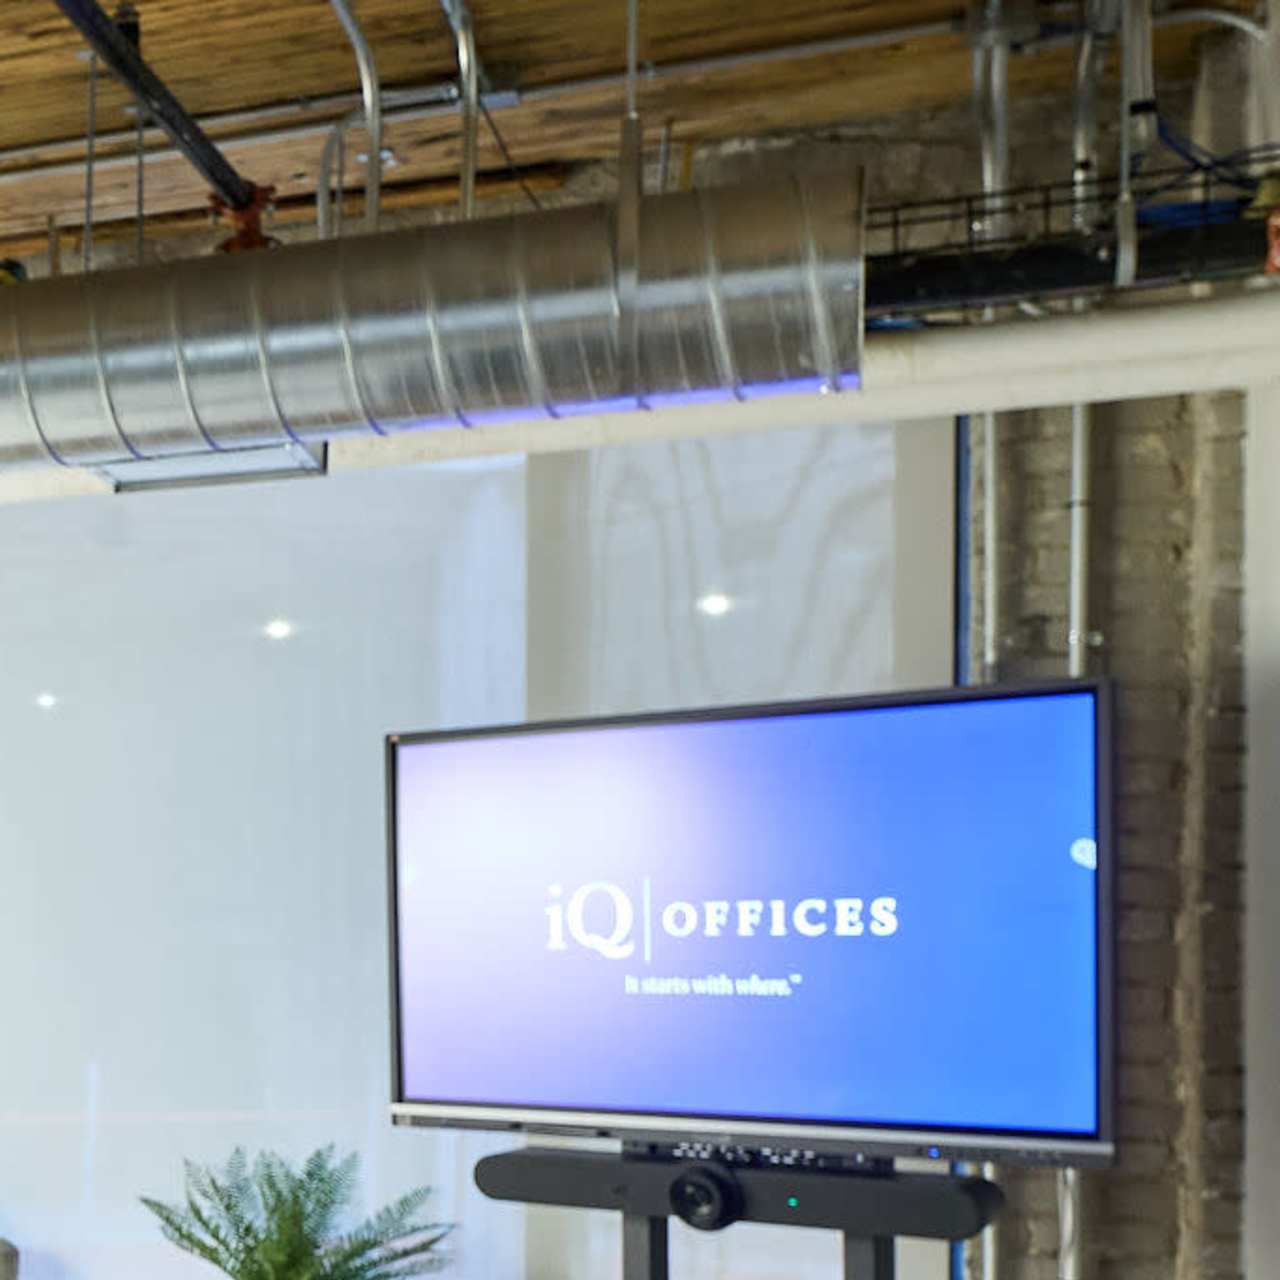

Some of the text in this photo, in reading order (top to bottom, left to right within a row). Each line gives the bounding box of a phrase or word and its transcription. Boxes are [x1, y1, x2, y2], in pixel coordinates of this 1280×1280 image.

[545, 881, 899, 960] iQ OFFICES
[640, 976, 690, 995] starts
[691, 973, 733, 995] with
